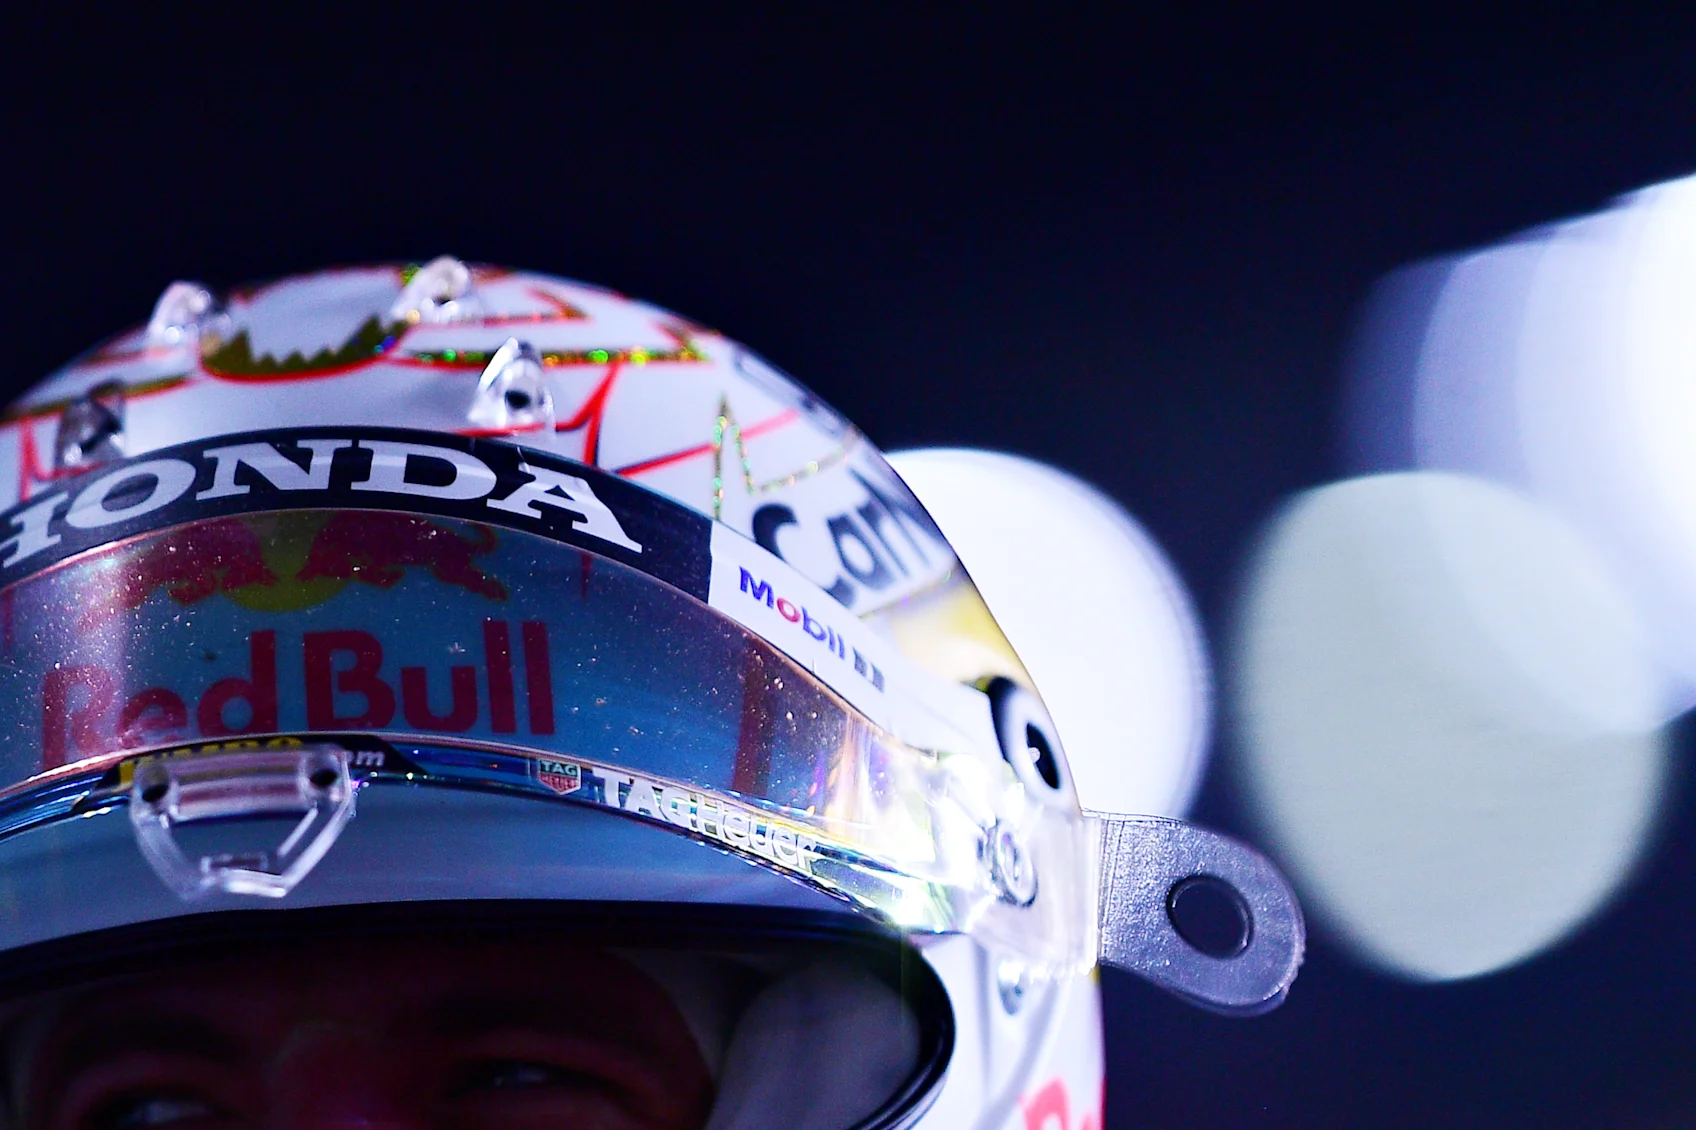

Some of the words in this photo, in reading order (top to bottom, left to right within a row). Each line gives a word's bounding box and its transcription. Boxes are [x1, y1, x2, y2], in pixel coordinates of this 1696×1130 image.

[739, 566, 845, 661] Mobil
[41, 629, 279, 775] Red
[305, 620, 555, 736] Bull
[541, 760, 577, 777] TAG
